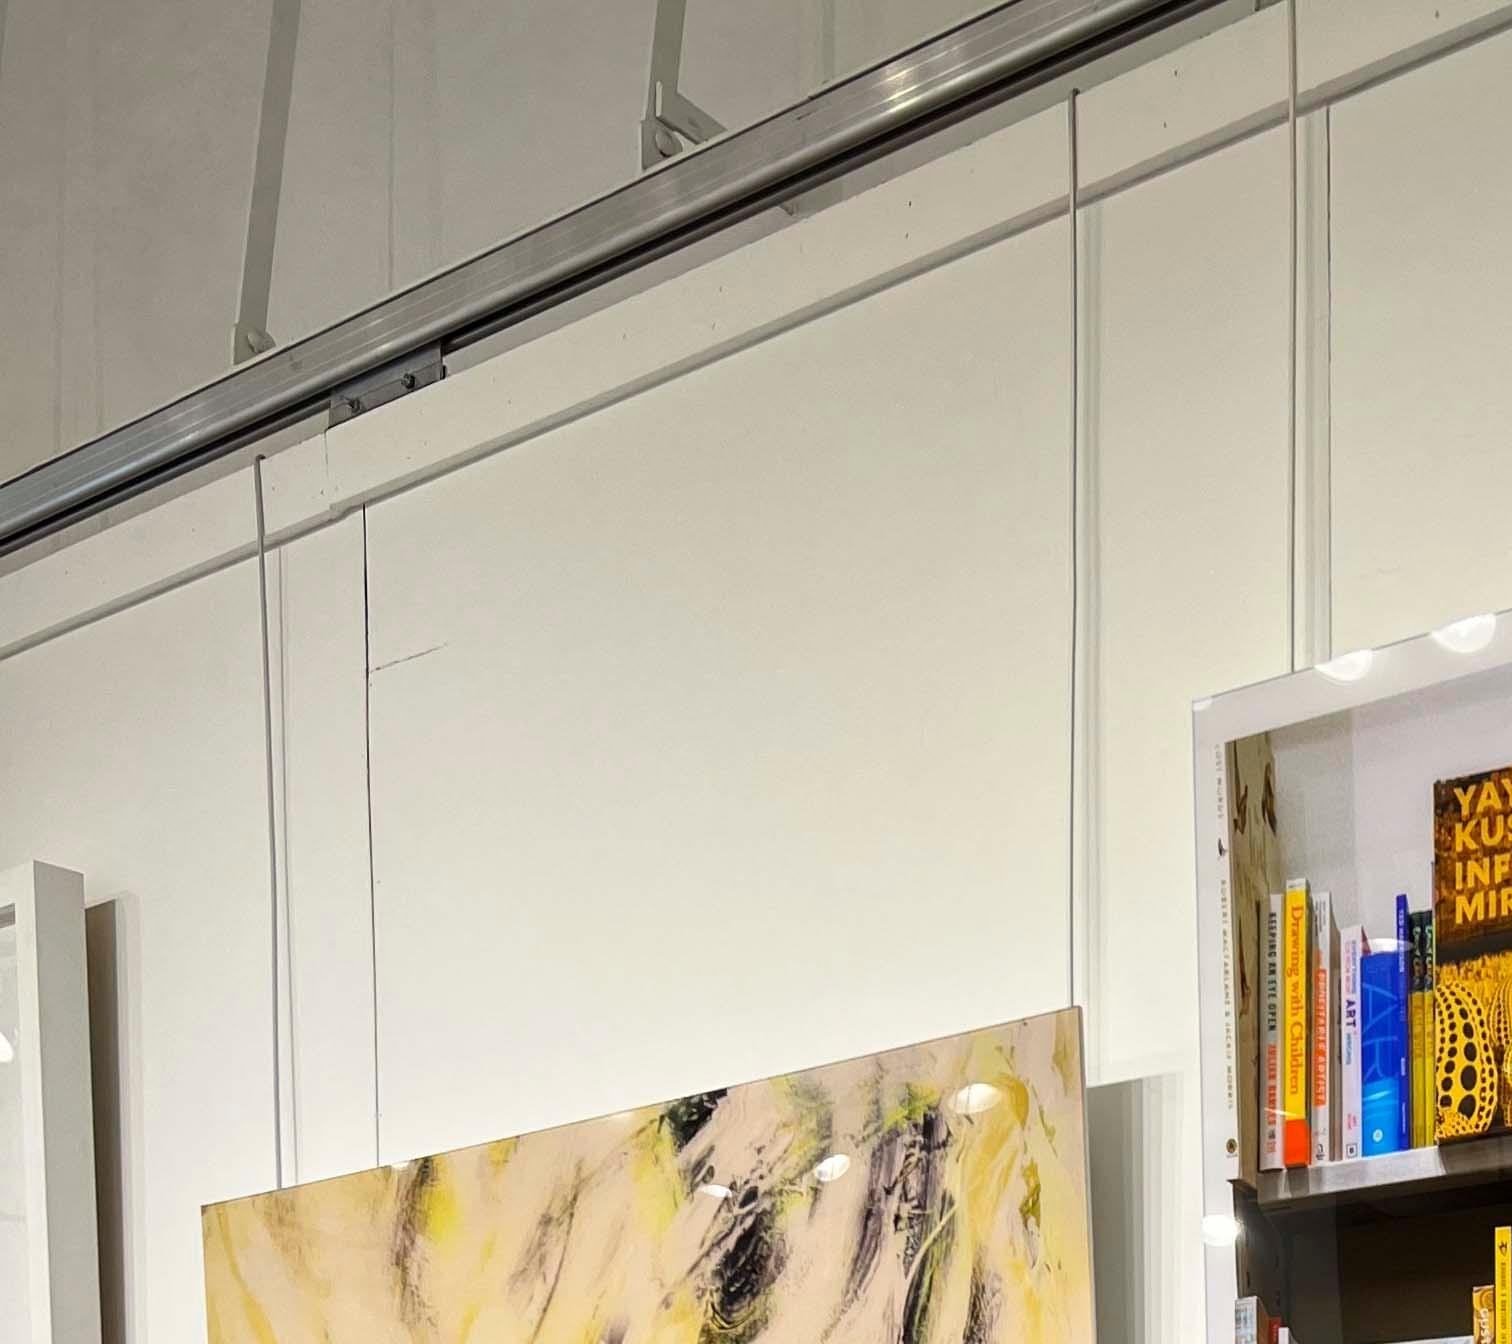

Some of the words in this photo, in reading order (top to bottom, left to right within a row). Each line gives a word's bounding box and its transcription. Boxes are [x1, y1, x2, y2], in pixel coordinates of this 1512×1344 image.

[1288, 906, 1304, 977] Drawing
[1290, 980, 1304, 1016] with
[1346, 1000, 1356, 1028] ART
[1290, 1021, 1304, 1095] Children
